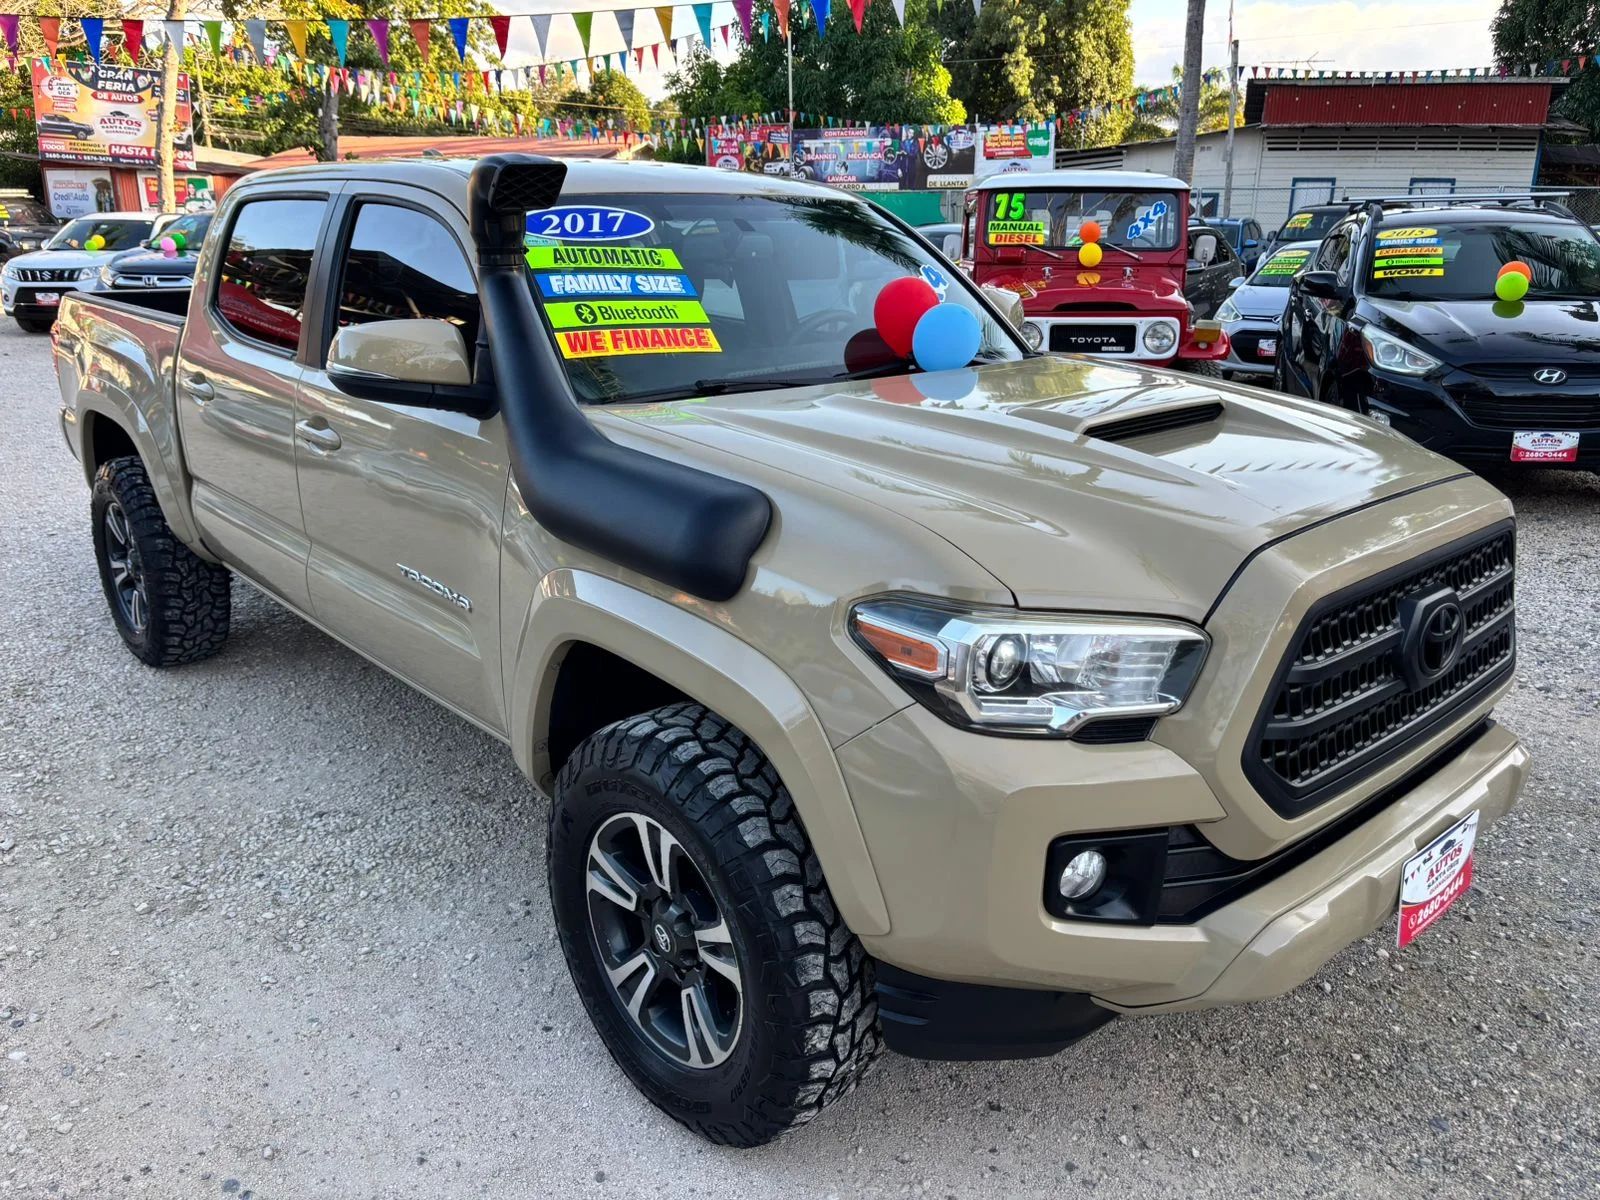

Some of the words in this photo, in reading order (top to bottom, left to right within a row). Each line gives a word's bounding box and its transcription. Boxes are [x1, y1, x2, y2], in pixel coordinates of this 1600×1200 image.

[98, 70, 134, 81] GRAN
[97, 80, 136, 92] FERIA
[96, 92, 109, 100] DE
[111, 94, 139, 103] AUTOS
[99, 118, 142, 127] AUTOS
[111, 145, 148, 157] HASTA
[995, 192, 1025, 220] 75
[540, 212, 626, 235] 2017
[990, 222, 1043, 231] MANUAL
[994, 233, 1040, 243] DIESEL
[1380, 238, 1415, 246] FAMILY
[553, 247, 665, 267] AUTOMATIC
[549, 274, 632, 294] FAMILY
[634, 274, 686, 294] SIZE
[598, 304, 679, 321] Bluetooth
[564, 330, 610, 353] WE
[610, 328, 713, 351] FINANCE
[1069, 336, 1117, 344] TOYOTA
[396, 562, 473, 610] TACOMA
[1427, 843, 1463, 883] AUTOS
[1417, 872, 1465, 924] 2680-0444
